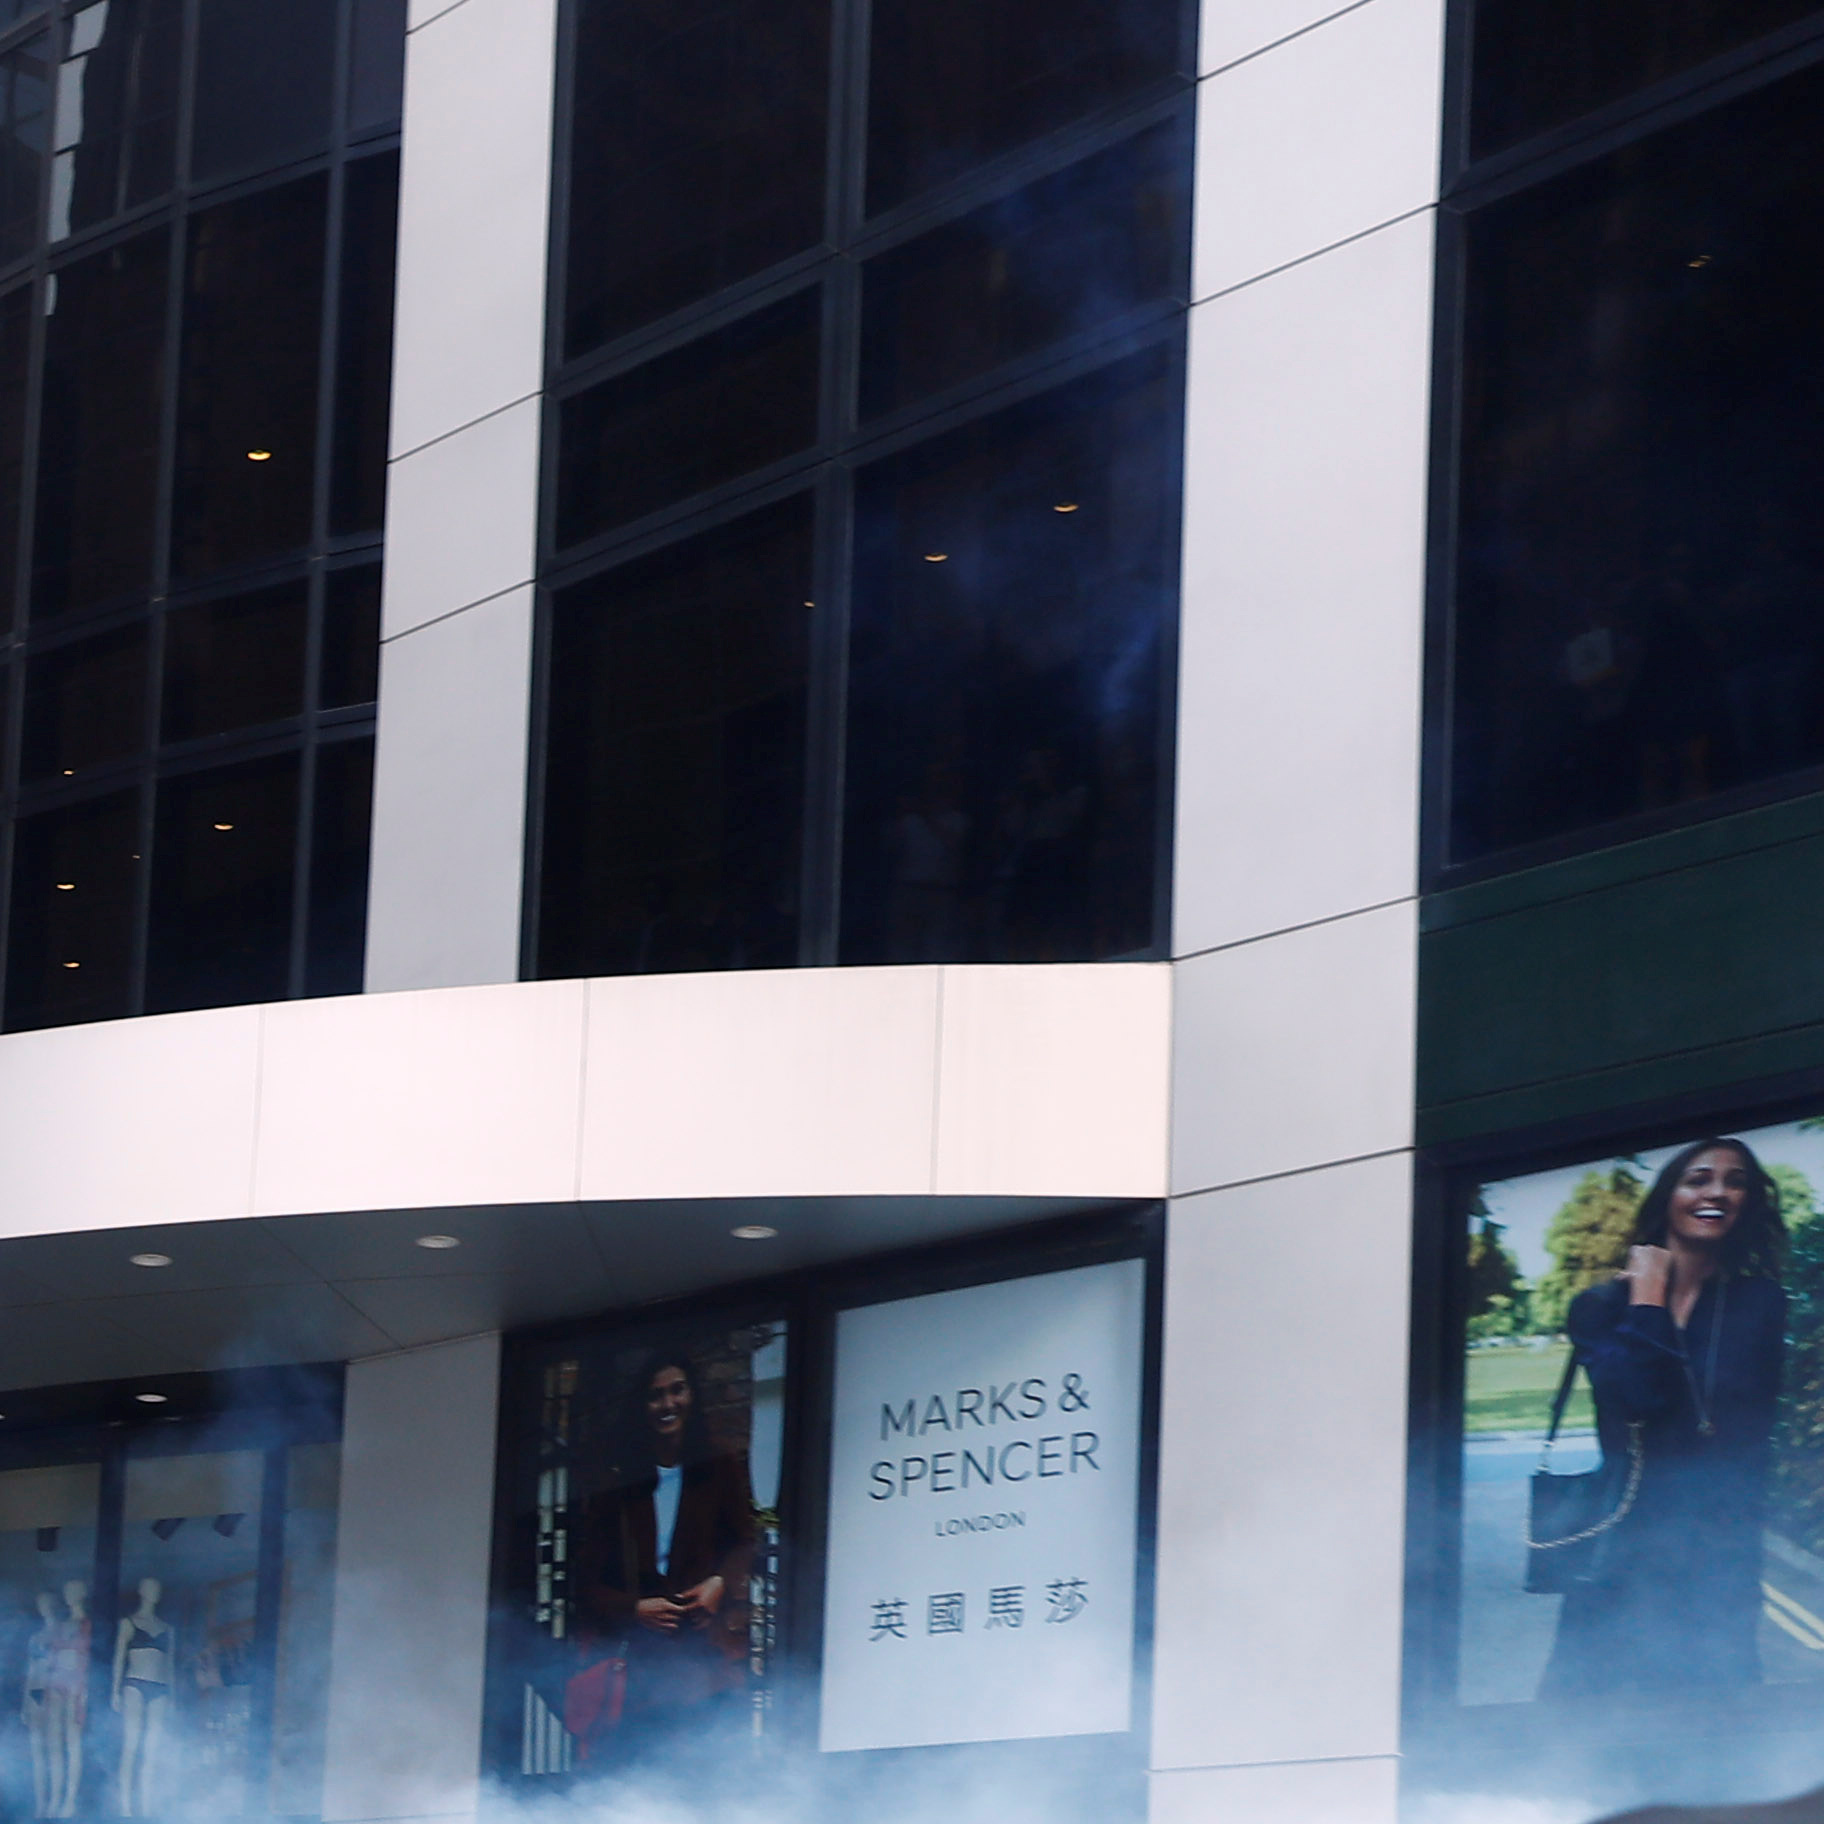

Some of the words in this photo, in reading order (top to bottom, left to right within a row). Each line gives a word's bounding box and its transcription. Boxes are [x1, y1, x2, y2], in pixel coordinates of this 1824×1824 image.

[880, 1378, 1048, 1441] MARKS
[1058, 1372, 1091, 1412] &
[868, 1431, 1101, 1501] SPENCER
[934, 1510, 1027, 1537] LONDON
[868, 1577, 1089, 1641] 英國馬莎
